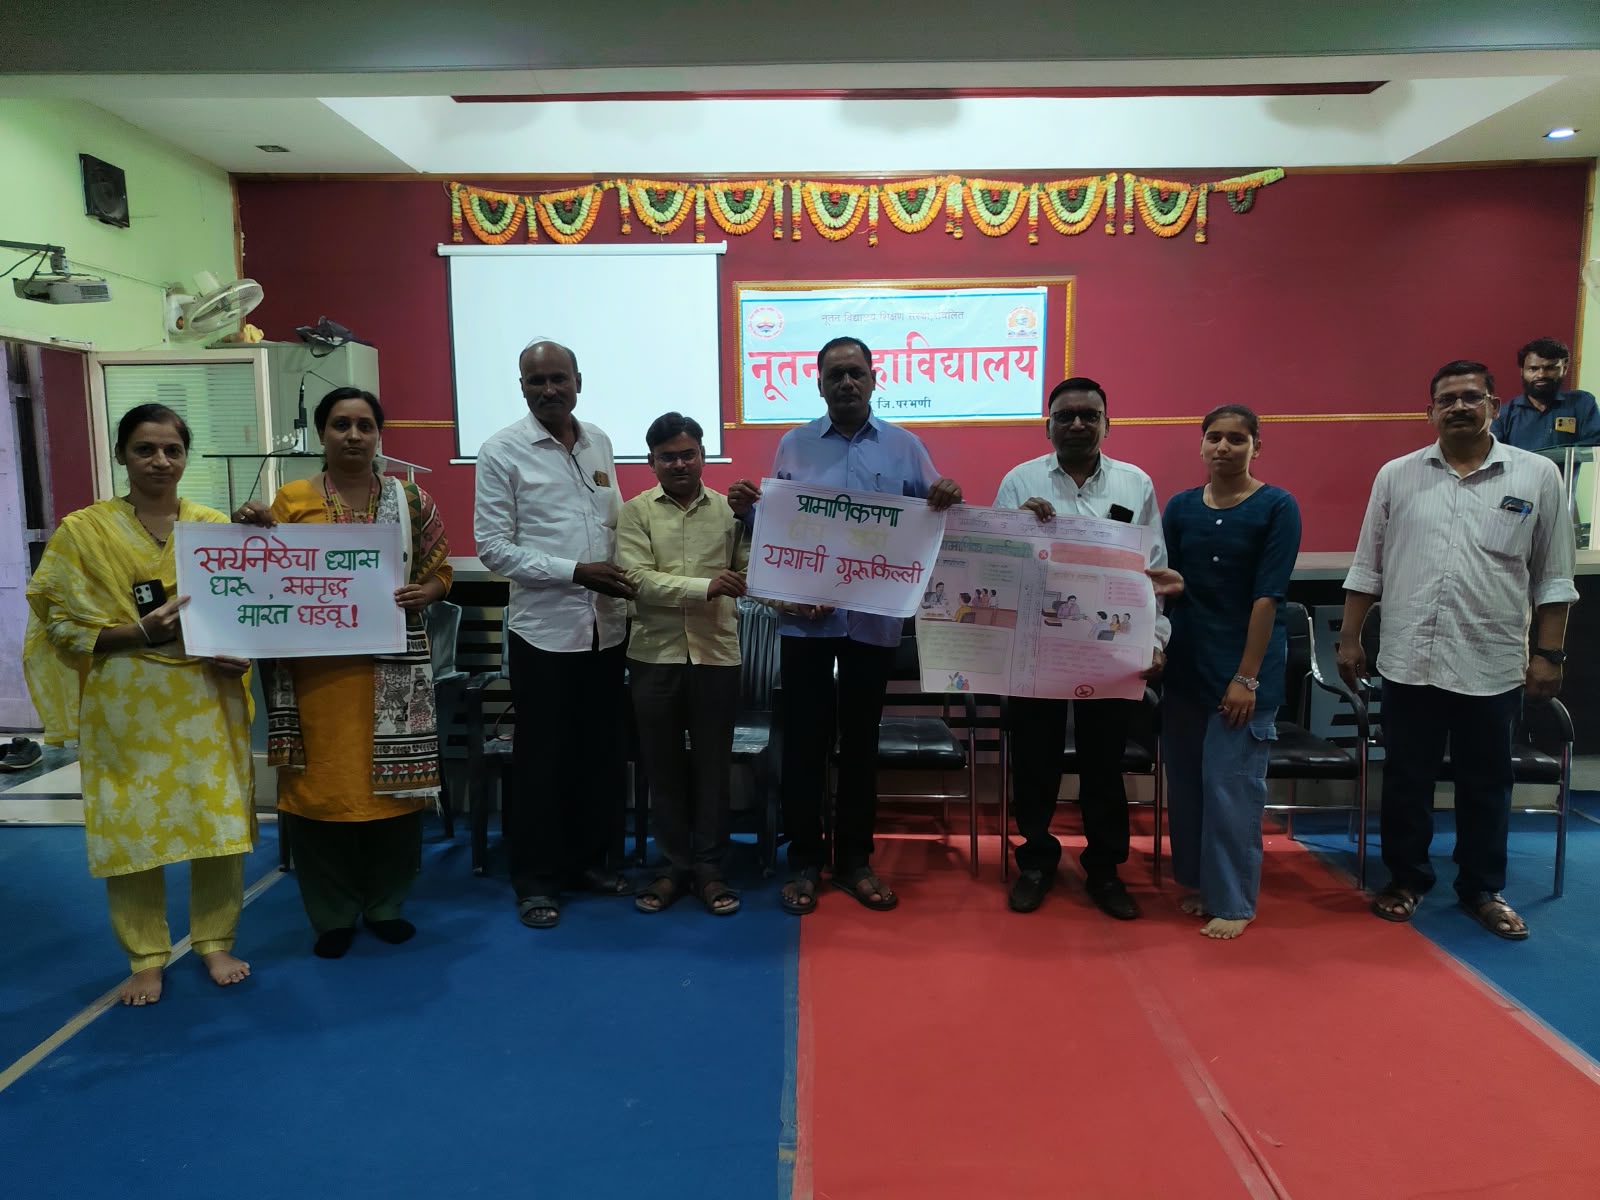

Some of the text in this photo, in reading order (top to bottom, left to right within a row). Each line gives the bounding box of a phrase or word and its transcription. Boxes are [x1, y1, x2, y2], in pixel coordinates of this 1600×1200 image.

[821, 313, 841, 326] नूतन
[870, 331, 1039, 391] हाविद्यालय
[796, 494, 905, 527] प्रामाणिकपणा
[193, 535, 381, 574] सत्यनिष्ठेचा ध्यास
[762, 544, 830, 573] यशाची
[280, 576, 354, 604] समृद्ध
[237, 604, 294, 627] भारत
